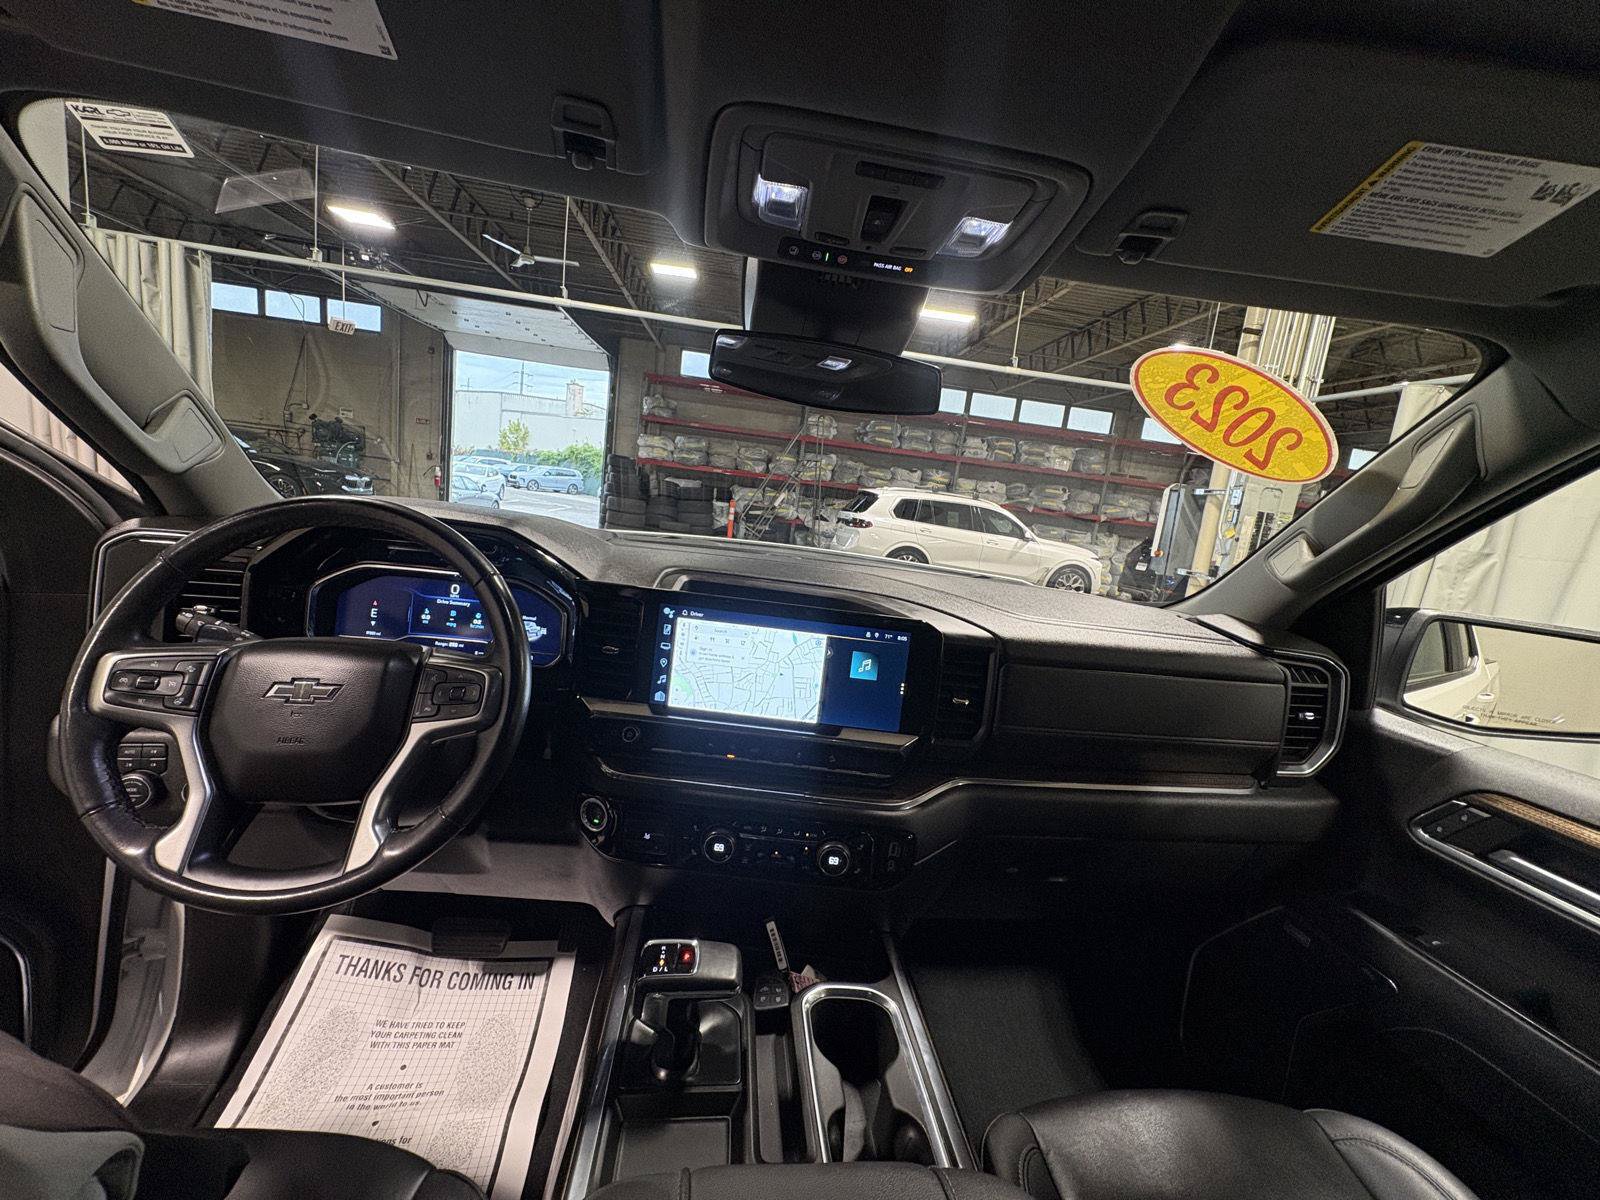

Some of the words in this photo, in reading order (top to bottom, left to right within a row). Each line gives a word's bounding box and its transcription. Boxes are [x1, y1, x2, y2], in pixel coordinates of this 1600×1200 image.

[334, 321, 352, 333] EXIT
[335, 954, 407, 983] THANKS
[408, 966, 444, 989] FOR
[447, 971, 513, 991] COMING
[517, 972, 537, 990] IN
[375, 1019, 389, 1028] WE
[389, 1021, 408, 1029] HAVE
[411, 1021, 434, 1029] TRIED
[435, 1021, 446, 1029] TO
[446, 1021, 466, 1029] KEEP
[370, 1030, 392, 1039] YOUR
[393, 1031, 437, 1039] CARPETING
[438, 1031, 463, 1039] CLEAN
[369, 1041, 390, 1049] WITH
[392, 1041, 411, 1049] THIS
[411, 1041, 437, 1049] PAPER
[438, 1041, 456, 1049] MAT
[366, 1083, 374, 1091] A
[374, 1082, 414, 1091] customer
[334, 1094, 349, 1102] the
[350, 1093, 372, 1101] most
[373, 1092, 415, 1102] important
[415, 1089, 445, 1099] person
[346, 1103, 356, 1111] in
[357, 1102, 371, 1111] the
[373, 1101, 398, 1110] world
[398, 1135, 413, 1145] for
